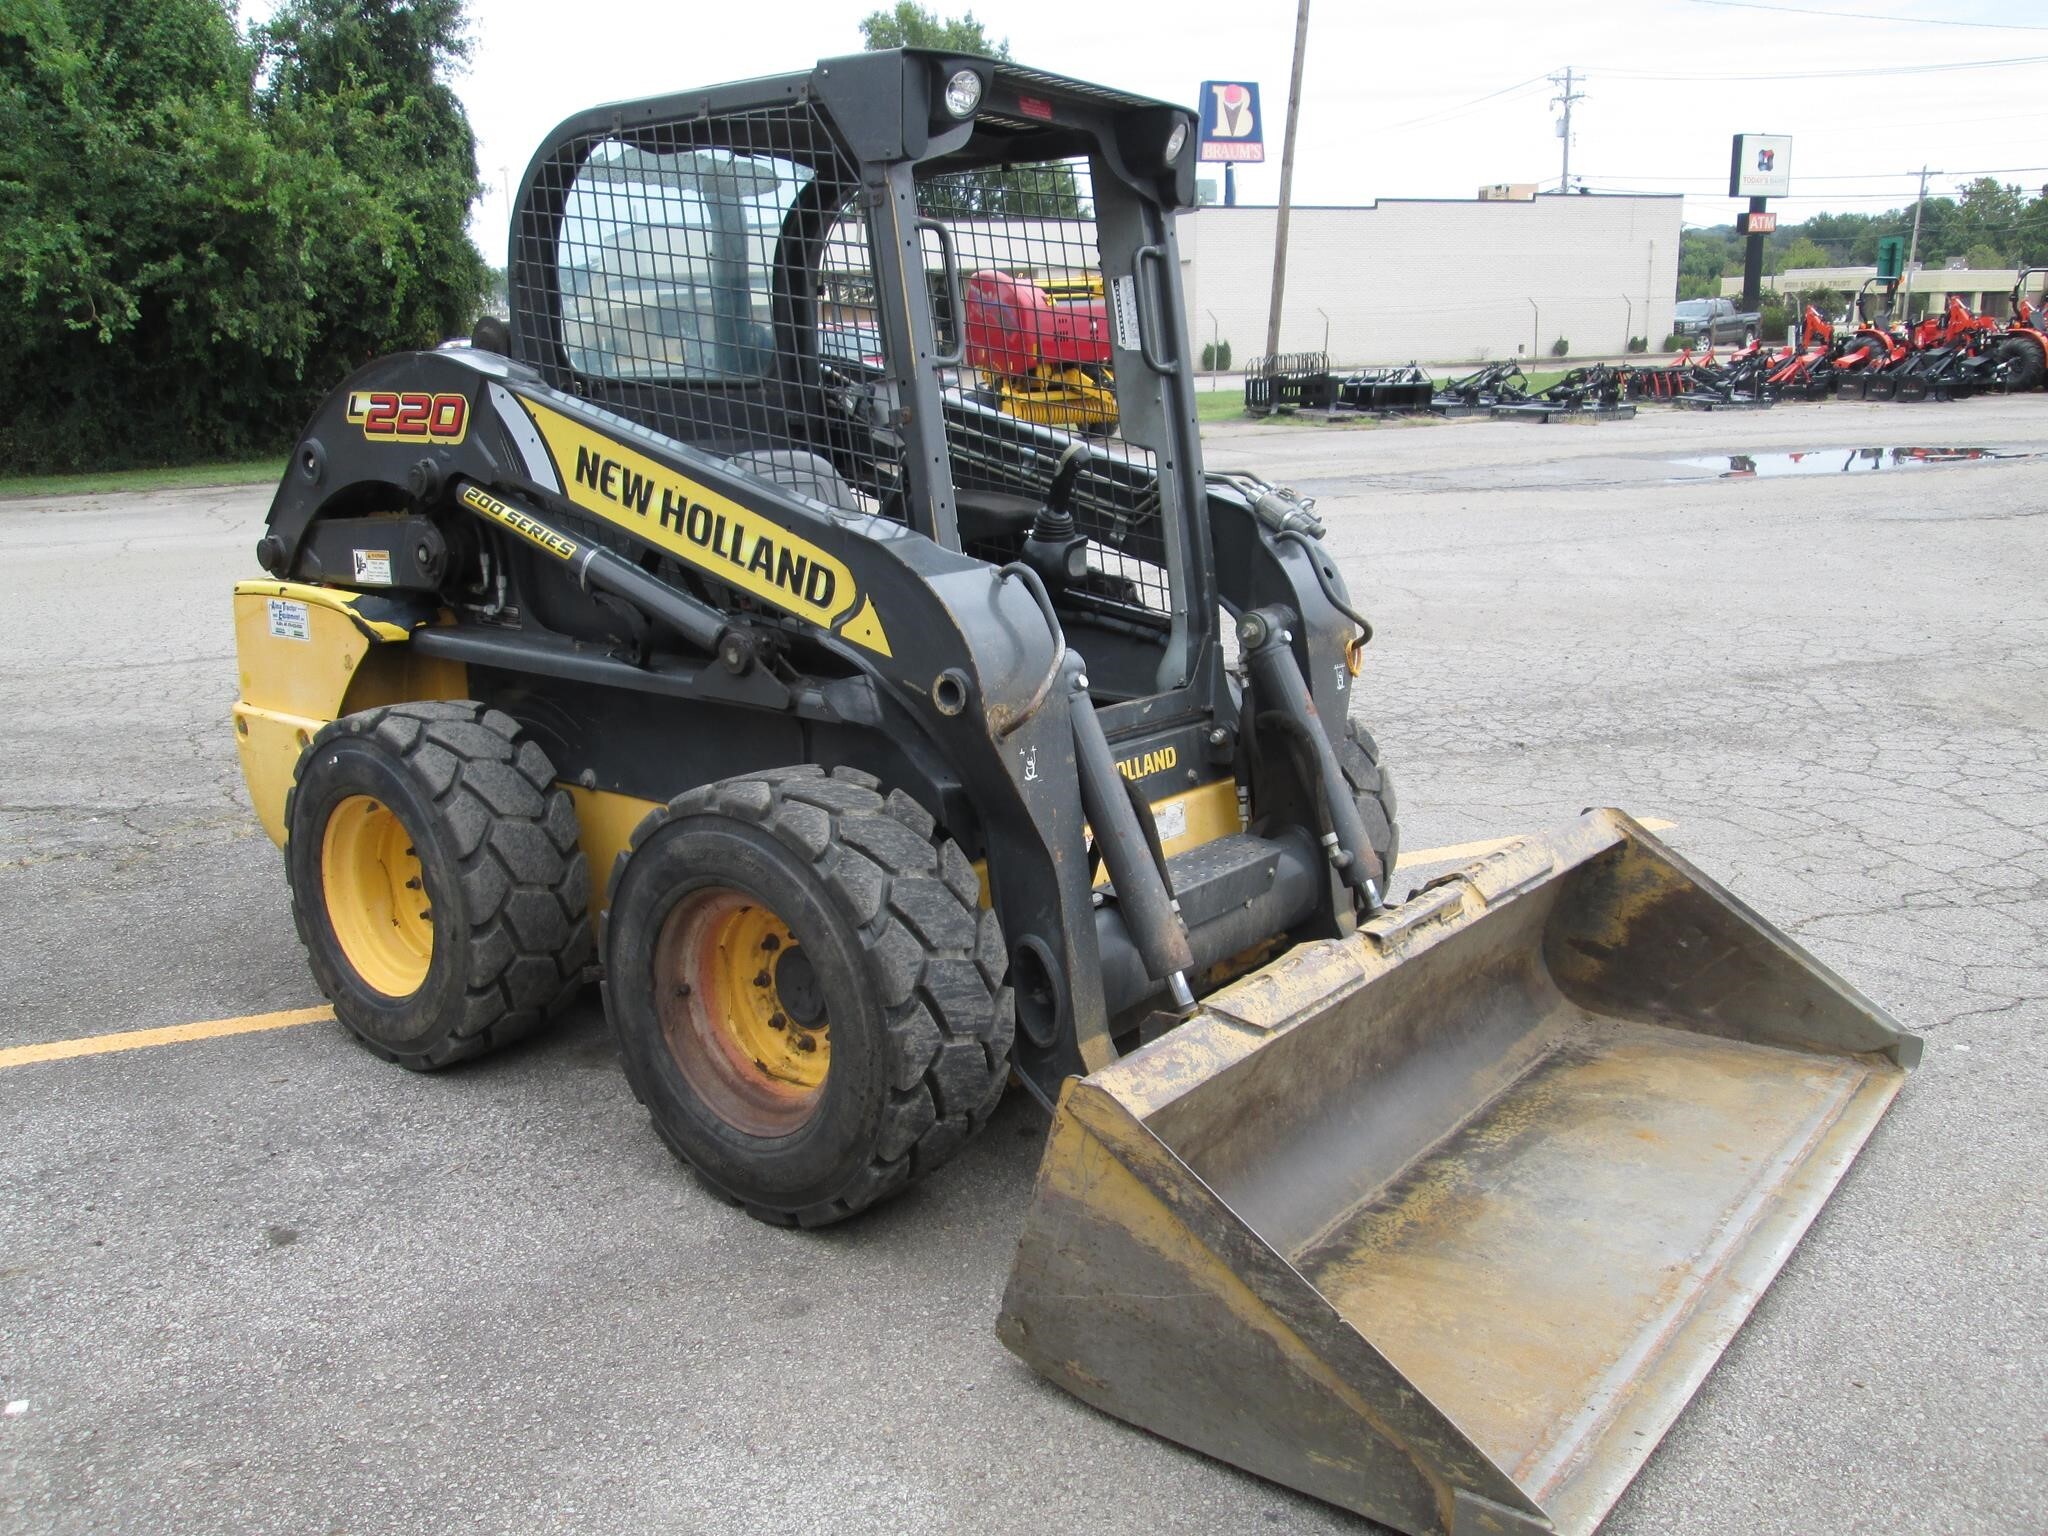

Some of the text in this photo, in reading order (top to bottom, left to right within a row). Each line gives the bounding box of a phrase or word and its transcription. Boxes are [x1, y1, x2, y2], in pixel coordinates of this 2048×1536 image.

[1203, 142, 1262, 160] BRAUM'S
[1749, 215, 1776, 231] ATM
[347, 393, 468, 439] L220
[465, 487, 576, 556] 200 SERIES
[575, 445, 837, 610] NEW HOLLAND
